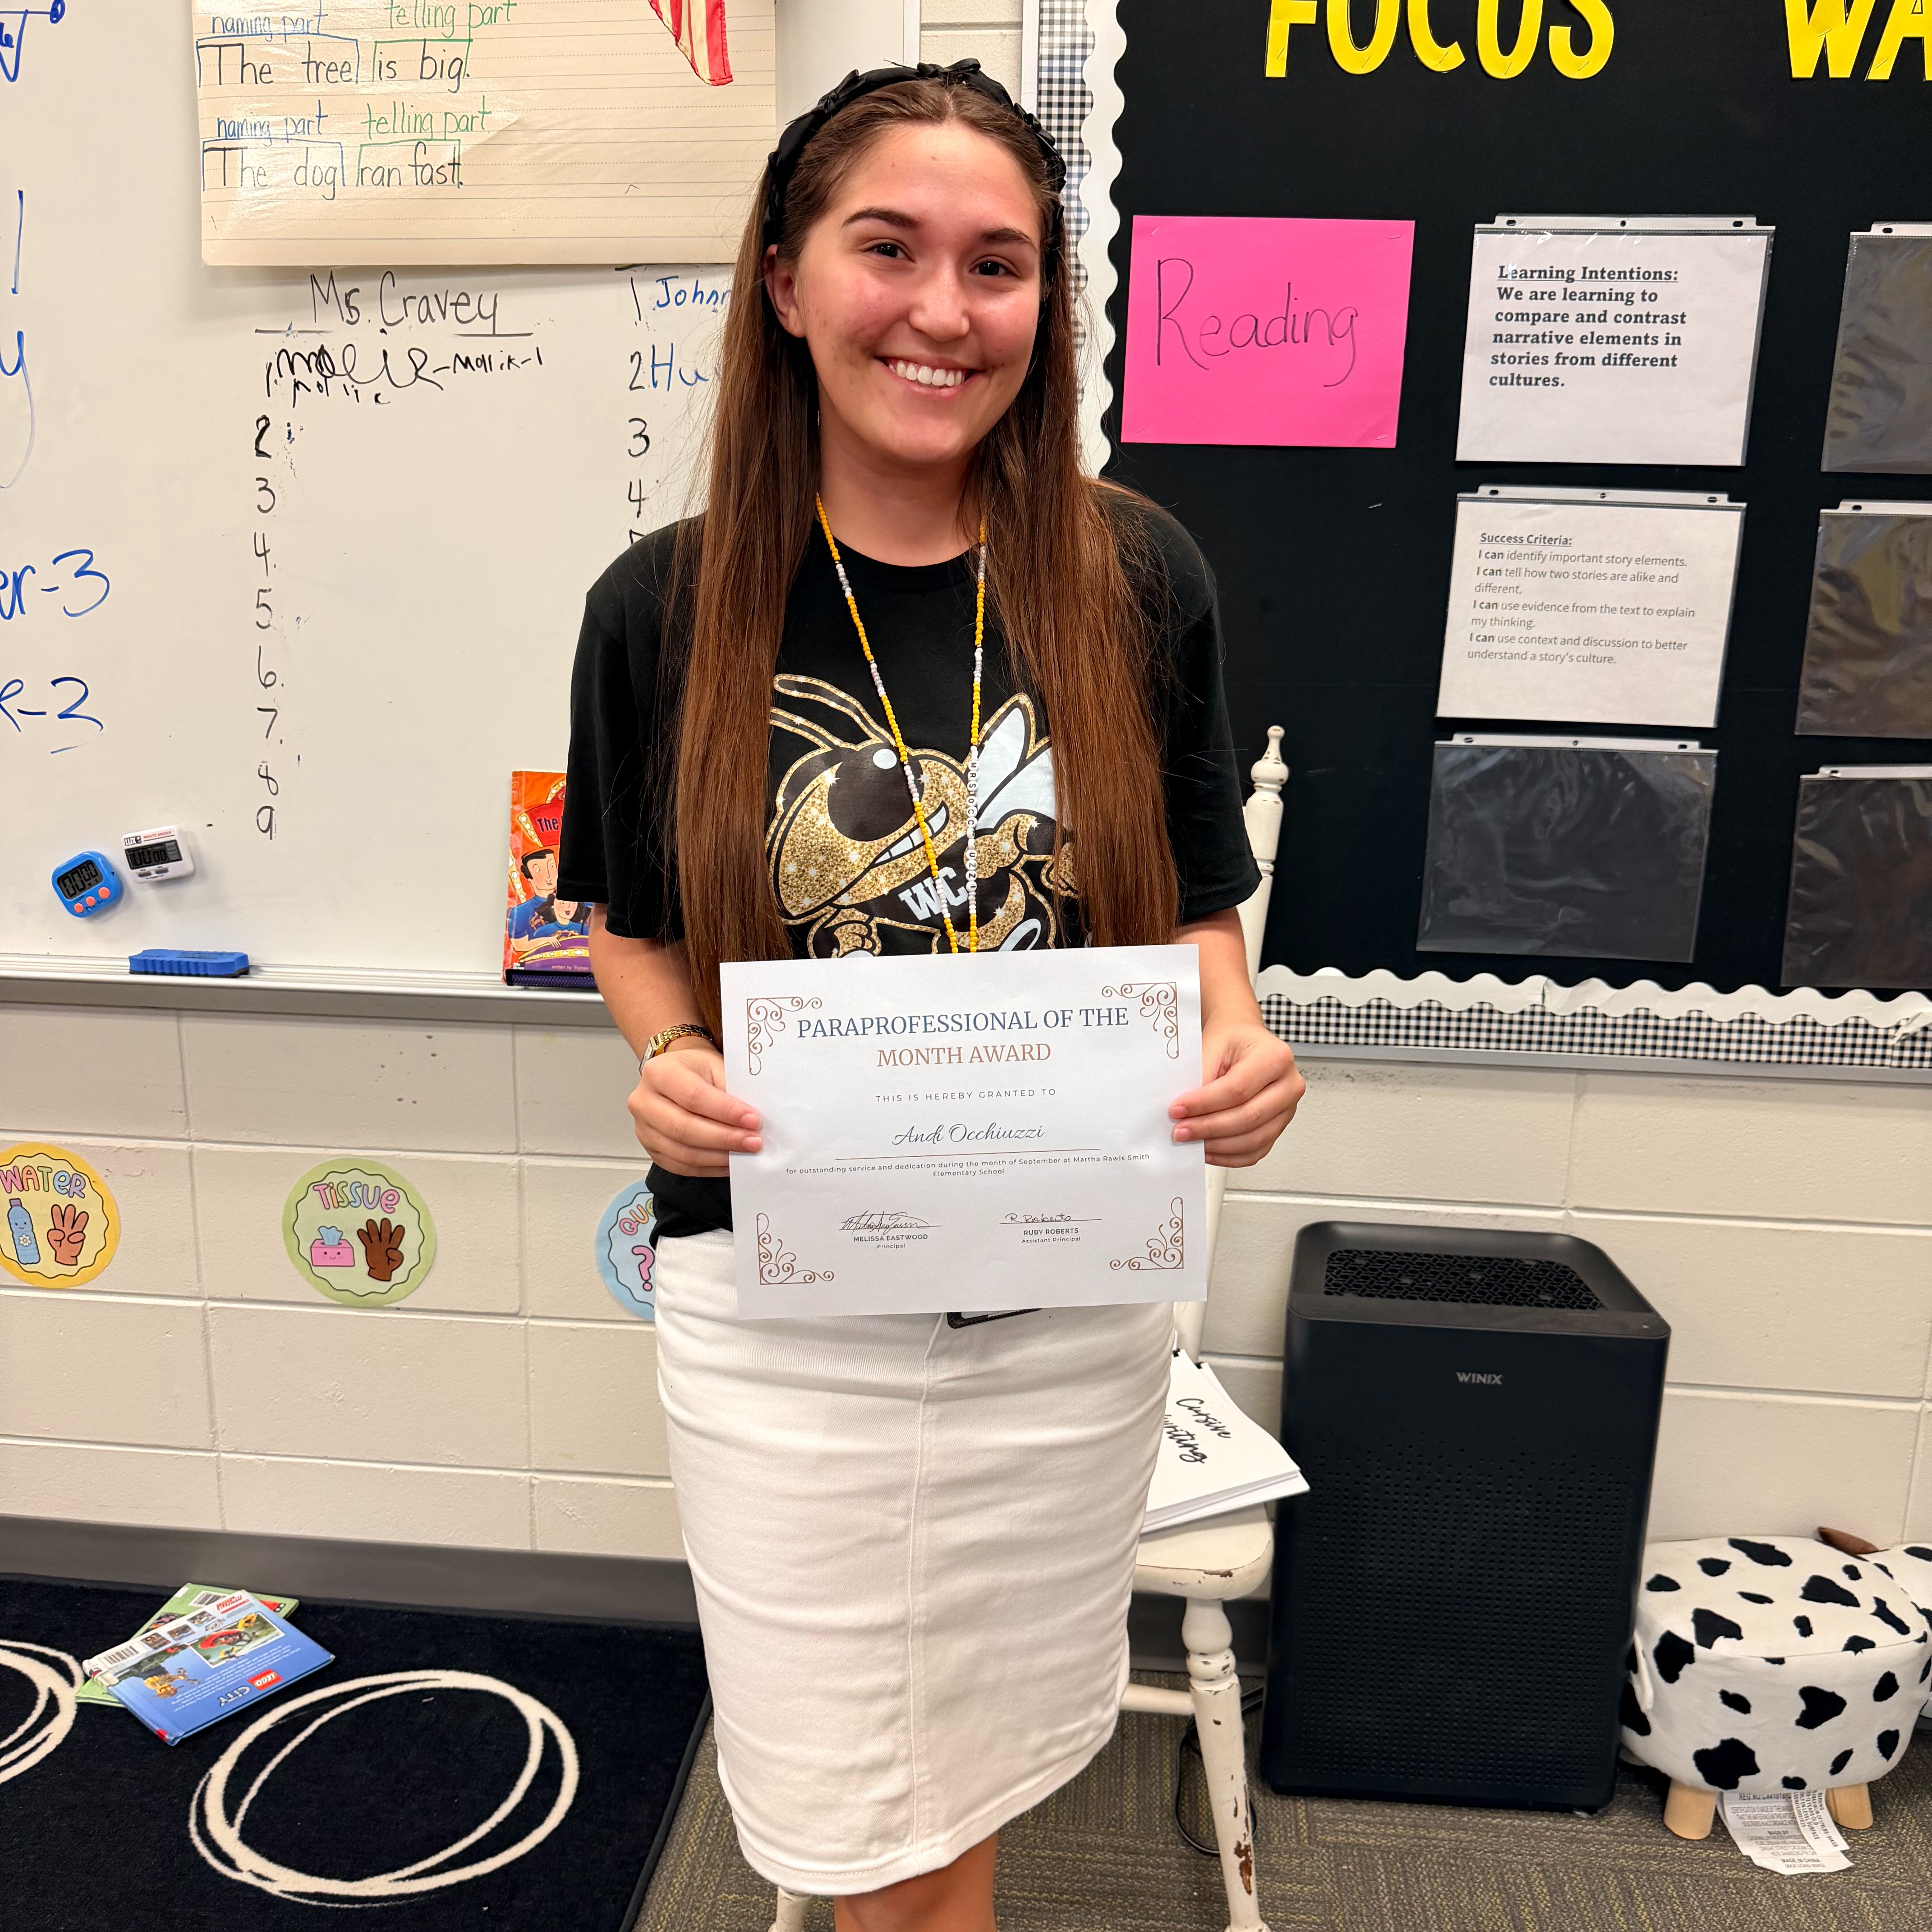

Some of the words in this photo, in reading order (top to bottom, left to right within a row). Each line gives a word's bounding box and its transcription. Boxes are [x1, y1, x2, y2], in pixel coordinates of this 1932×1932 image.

[212, 14, 272, 41] naming
[281, 0, 328, 42] part
[385, 1, 455, 37] telling
[468, 1, 518, 38] part
[1265, 0, 1615, 79] FOCUS
[198, 44, 274, 84] The
[302, 41, 354, 84] tree
[378, 52, 396, 79] is
[217, 112, 271, 146] naming
[285, 100, 328, 143] part
[361, 102, 433, 140] telling
[444, 95, 492, 140] part
[203, 146, 268, 187] The
[294, 147, 336, 200] dog
[360, 165, 402, 188] ran
[1497, 265, 1575, 282] Learning
[1581, 266, 1679, 282] Intentions:
[379, 271, 498, 335] Cravey
[1497, 287, 1523, 301] We
[1529, 289, 1556, 301] are
[1562, 287, 1635, 306] learning
[1640, 290, 1658, 303] to
[1157, 258, 1358, 387] Reading
[1495, 311, 1569, 326] compare
[1575, 310, 1607, 324] and
[1613, 311, 1687, 325] contrast
[1492, 331, 1573, 345] narrative
[1579, 331, 1659, 346] elements
[1664, 332, 1682, 346] in
[1490, 352, 1549, 365] stories
[1554, 353, 1596, 366] from
[1601, 353, 1678, 367] different
[1489, 373, 1565, 387] cultures.
[628, 418, 650, 457] 3
[255, 477, 276, 514] 3
[628, 479, 649, 518] 4
[1480, 532, 1524, 545] Success
[1526, 534, 1572, 547] Criteria:
[1478, 550, 1482, 559] I
[1484, 551, 1504, 560] can
[1506, 551, 1547, 563] identify
[1549, 552, 1603, 565] important
[1605, 554, 1633, 566] story
[1635, 555, 1687, 567] elements.
[1477, 567, 1480, 576] I
[1482, 568, 1502, 577] can
[1505, 567, 1522, 577] tell
[1524, 568, 1547, 579] how
[1550, 570, 1569, 580] two
[1572, 570, 1607, 581] stories
[1610, 573, 1627, 582] are
[1629, 572, 1655, 583] alike
[1658, 573, 1678, 584] and
[1475, 583, 1522, 594] different.
[1473, 600, 1477, 609] I
[1479, 601, 1498, 610] can
[1522, 602, 1569, 612] evidence
[1571, 603, 1597, 613] from
[1600, 604, 1617, 615] the
[1620, 606, 1641, 616] text
[1642, 607, 1653, 616] to
[1656, 607, 1695, 618] explain
[1471, 620, 1487, 628] my
[1490, 616, 1535, 630] thinking.
[1470, 632, 1473, 642] I
[1475, 634, 1494, 643] can
[1497, 635, 1515, 644] use
[1518, 636, 1558, 646] context
[1560, 636, 1580, 647] and
[1582, 637, 1638, 649] discussion
[1641, 639, 1652, 649] to
[1655, 639, 1687, 650] better
[1467, 650, 1527, 661] understand
[1538, 652, 1573, 664] story's
[1576, 653, 1616, 664] culture.
[538, 818, 559, 832] The
[124, 837, 137, 846] LUX
[898, 866, 968, 921] WC
[797, 1011, 1037, 1038] PARAPROFESSIONAL
[1043, 1009, 1074, 1028] OF
[1079, 1007, 1129, 1026] THE
[877, 1046, 962, 1067] MONTH
[969, 1043, 1051, 1063] AWARD
[926, 1092, 973, 1100] HEREBY
[979, 1089, 1035, 1098] GRANTED
[892, 1124, 944, 1145] Andi
[948, 1122, 1045, 1143] Occhiuzzi
[1456, 1372, 1503, 1385] WINIX
[1176, 1398, 1231, 1439] Cursive
